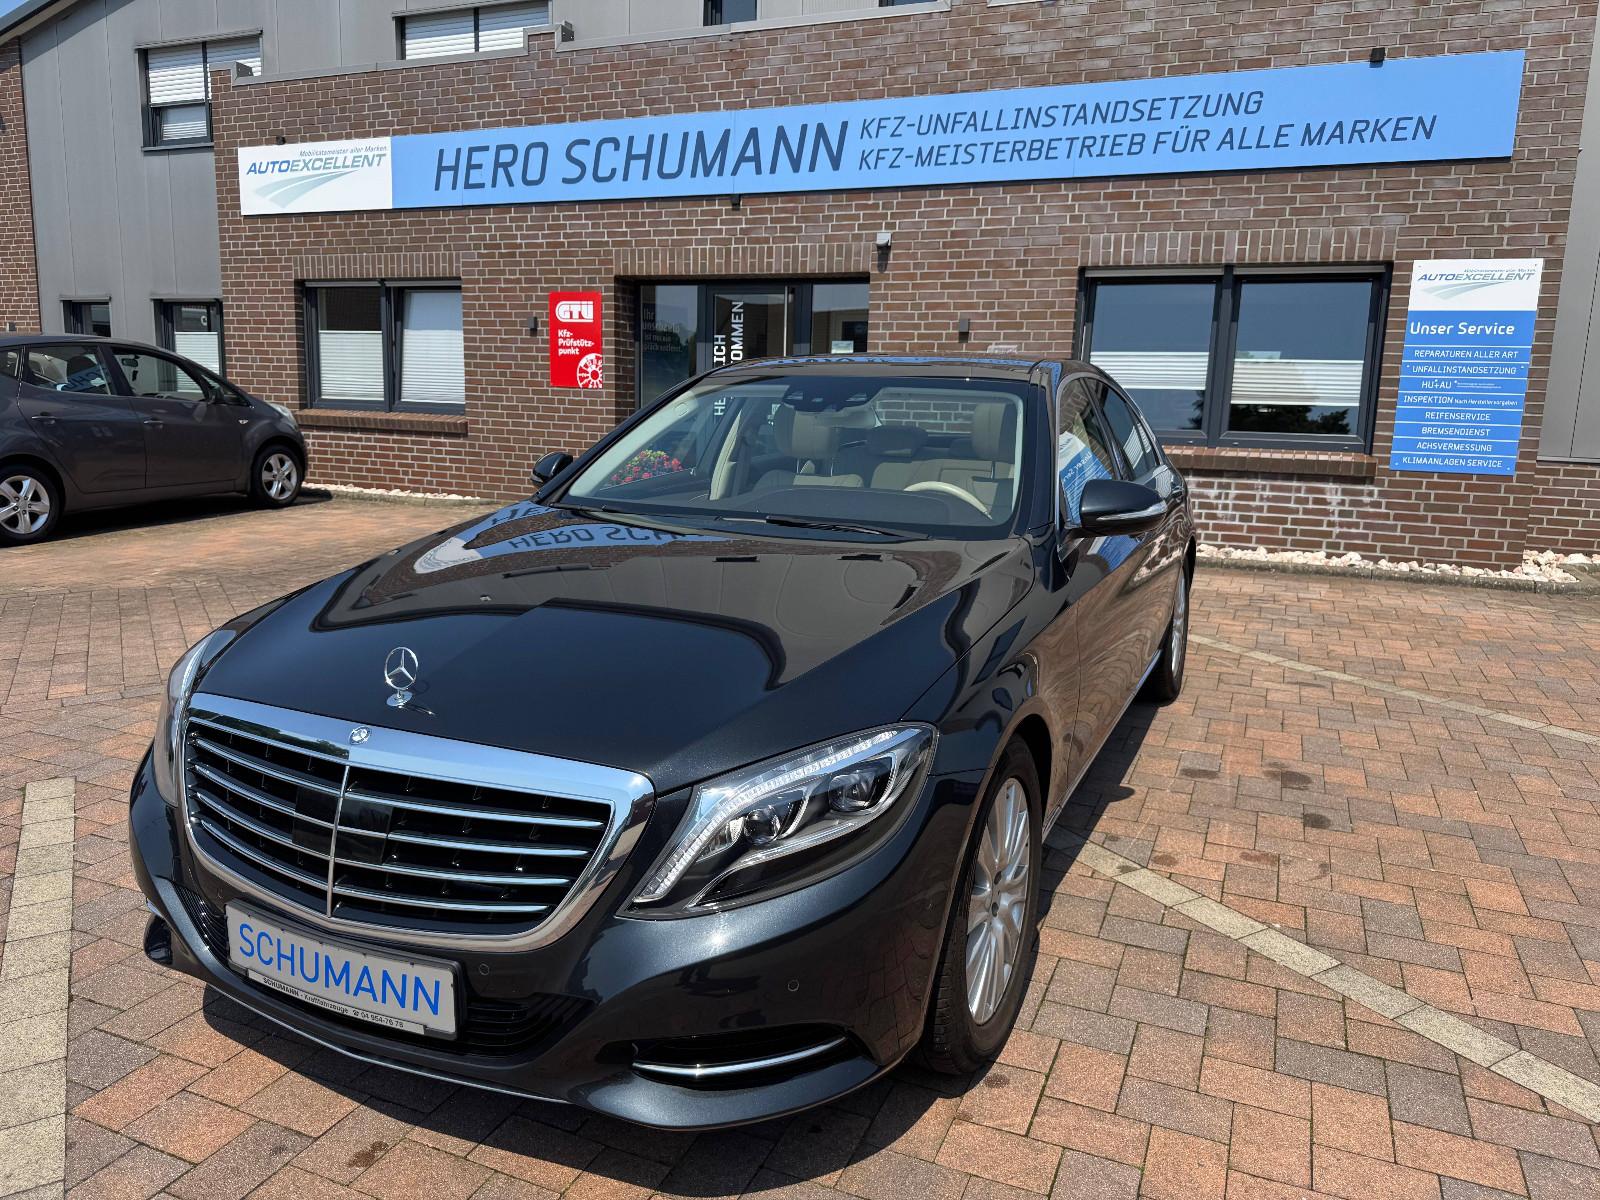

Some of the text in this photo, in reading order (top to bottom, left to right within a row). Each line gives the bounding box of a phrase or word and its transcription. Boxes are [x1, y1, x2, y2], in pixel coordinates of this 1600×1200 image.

[860, 90, 1263, 140] KFZ-UNFALLINSTANDSETZUNG
[858, 115, 1437, 171] KFZ-MEISTERBETRIEB FÜR ALLE MARKEN
[434, 120, 849, 191] HERO SCHUMANN
[246, 153, 387, 175] AUTOEXCELLENT
[1418, 273, 1535, 281] AUTOEXCELLENT
[558, 329, 573, 338] Kfz-
[1410, 322, 1515, 335] Unser Service
[558, 338, 595, 347] Prüfstütz-
[558, 347, 580, 356] punkt
[1414, 350, 1519, 359] REPARATUREN ALLER ART
[1412, 365, 1517, 375] UNFALLINSTANDSETZUNG
[1403, 395, 1454, 404] INSPEKTION
[1425, 411, 1492, 421] REIFENSERVICE
[1421, 426, 1491, 437] BREMSENDIENST
[1416, 441, 1493, 452] ACHSVERMESSUNG
[1402, 456, 1503, 468] KLIMAANLAGEN SERVICE
[238, 923, 441, 1016] SCHUMANN
